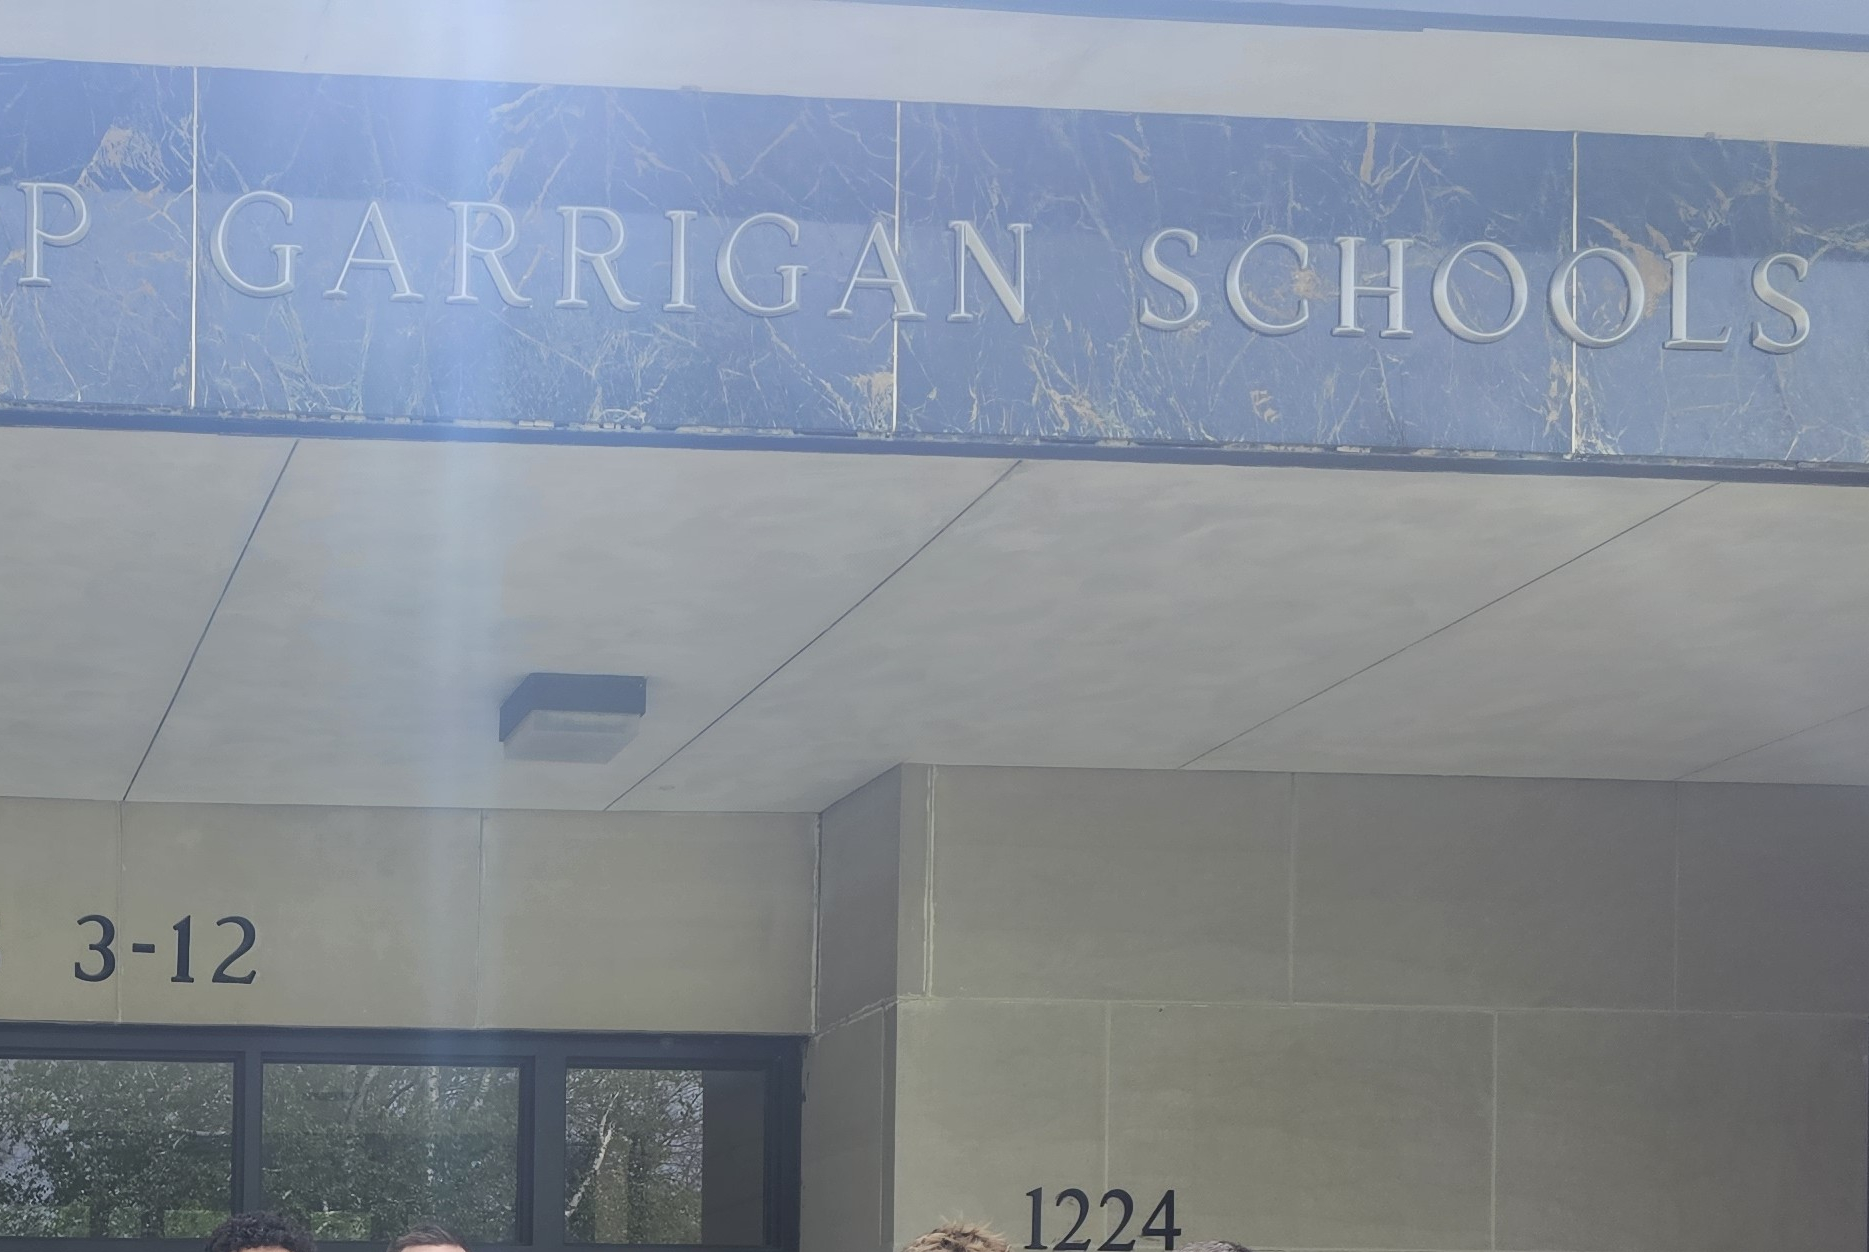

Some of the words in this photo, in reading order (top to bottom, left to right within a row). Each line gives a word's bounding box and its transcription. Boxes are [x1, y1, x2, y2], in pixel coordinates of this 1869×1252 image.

[209, 189, 1033, 324] GARRIGAN
[1138, 227, 1810, 356] SCHOOLS
[74, 914, 258, 985] 3-12
[1024, 1187, 1182, 1251] 1224
